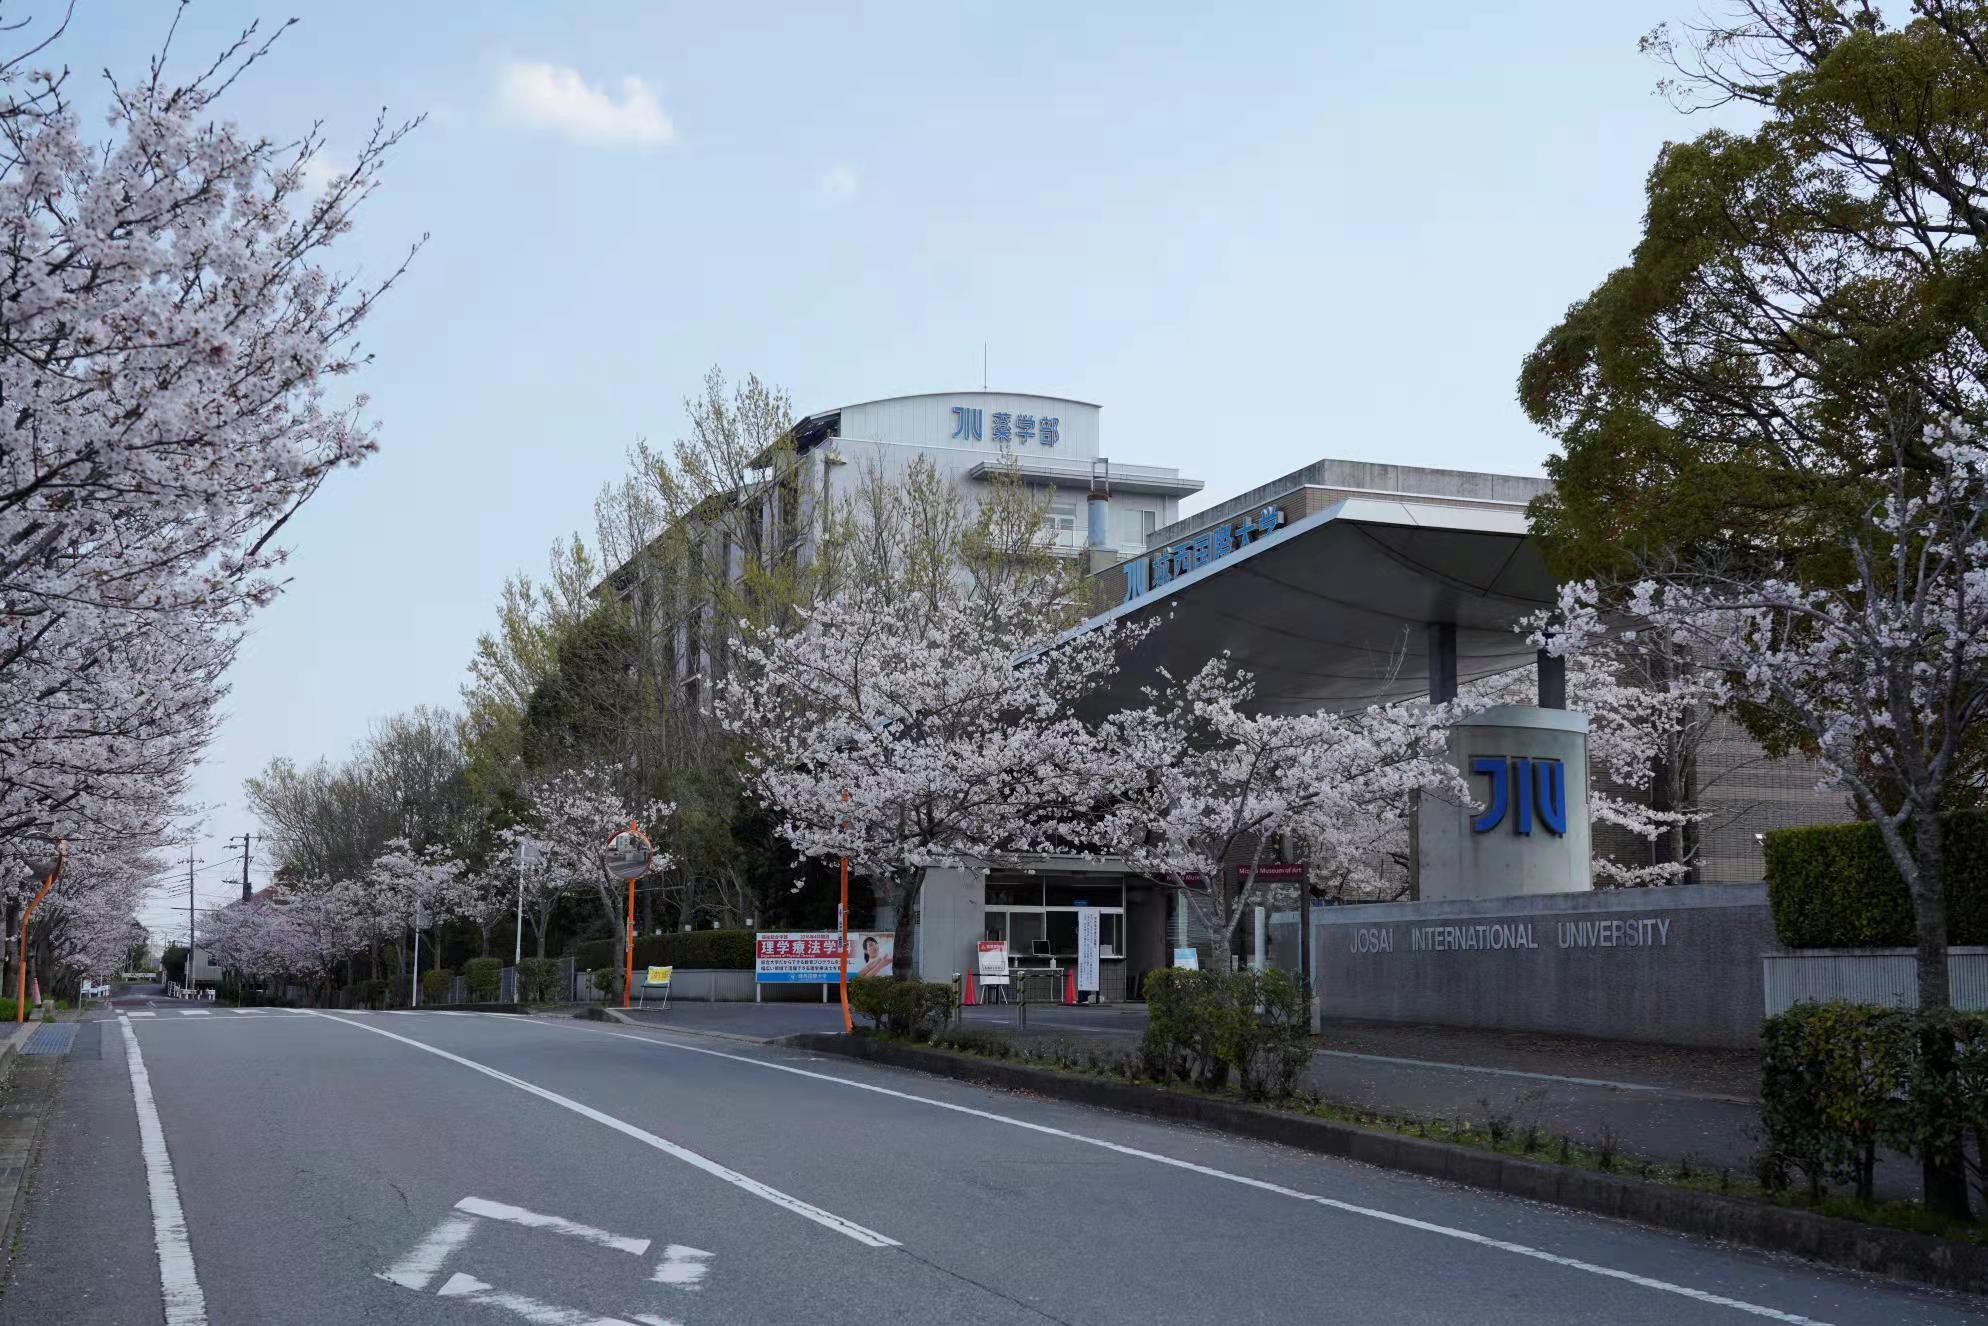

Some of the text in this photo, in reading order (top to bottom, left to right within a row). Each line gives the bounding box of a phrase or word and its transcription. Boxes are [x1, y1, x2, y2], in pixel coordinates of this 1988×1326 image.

[992, 411, 1060, 447] 薬学部
[761, 940, 851, 954] 理学療法学
[1350, 918, 1671, 954] JOSAI INTERNATIONAL UNIVERSITY
